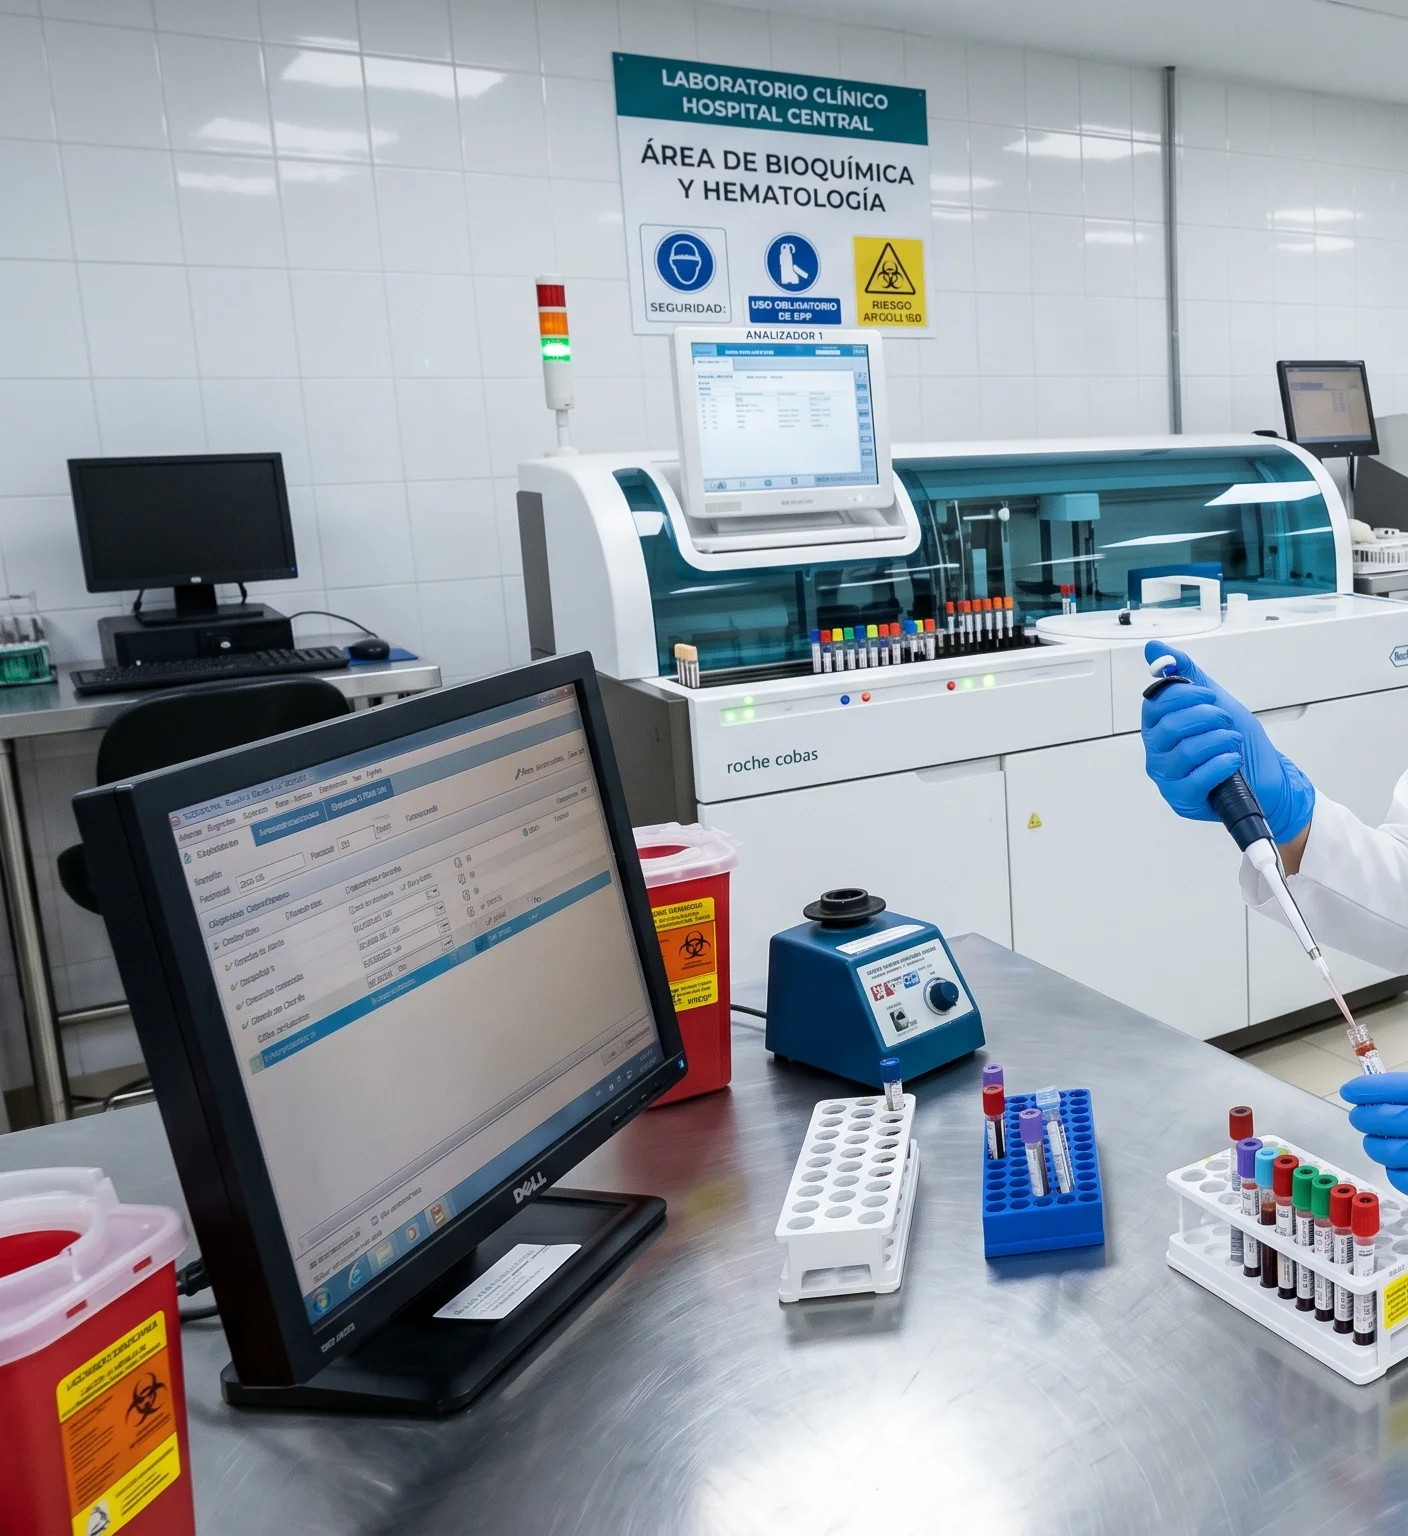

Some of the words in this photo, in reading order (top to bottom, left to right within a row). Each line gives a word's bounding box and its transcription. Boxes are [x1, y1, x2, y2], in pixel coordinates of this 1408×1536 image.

[661, 69, 808, 101] LABORATORIO
[812, 86, 889, 110] CLÍNICO
[682, 97, 783, 124] HOSPITAL
[787, 108, 874, 132] CENTRAL
[640, 138, 715, 170] ÁREA
[722, 150, 758, 173] DE
[766, 153, 915, 186] BIOQUÍMICA
[677, 178, 696, 199] Y
[703, 180, 886, 213] HEMATOLOGÍA
[650, 302, 727, 315] SEGURIDAD:
[751, 300, 773, 310] USO
[778, 312, 792, 321] DE
[793, 312, 813, 321] EPP
[871, 300, 912, 311] RIESGO
[745, 330, 815, 341] ANALIZADOR
[727, 755, 770, 774] roche
[775, 749, 818, 766] cobas
[513, 1172, 547, 1204] DELL
